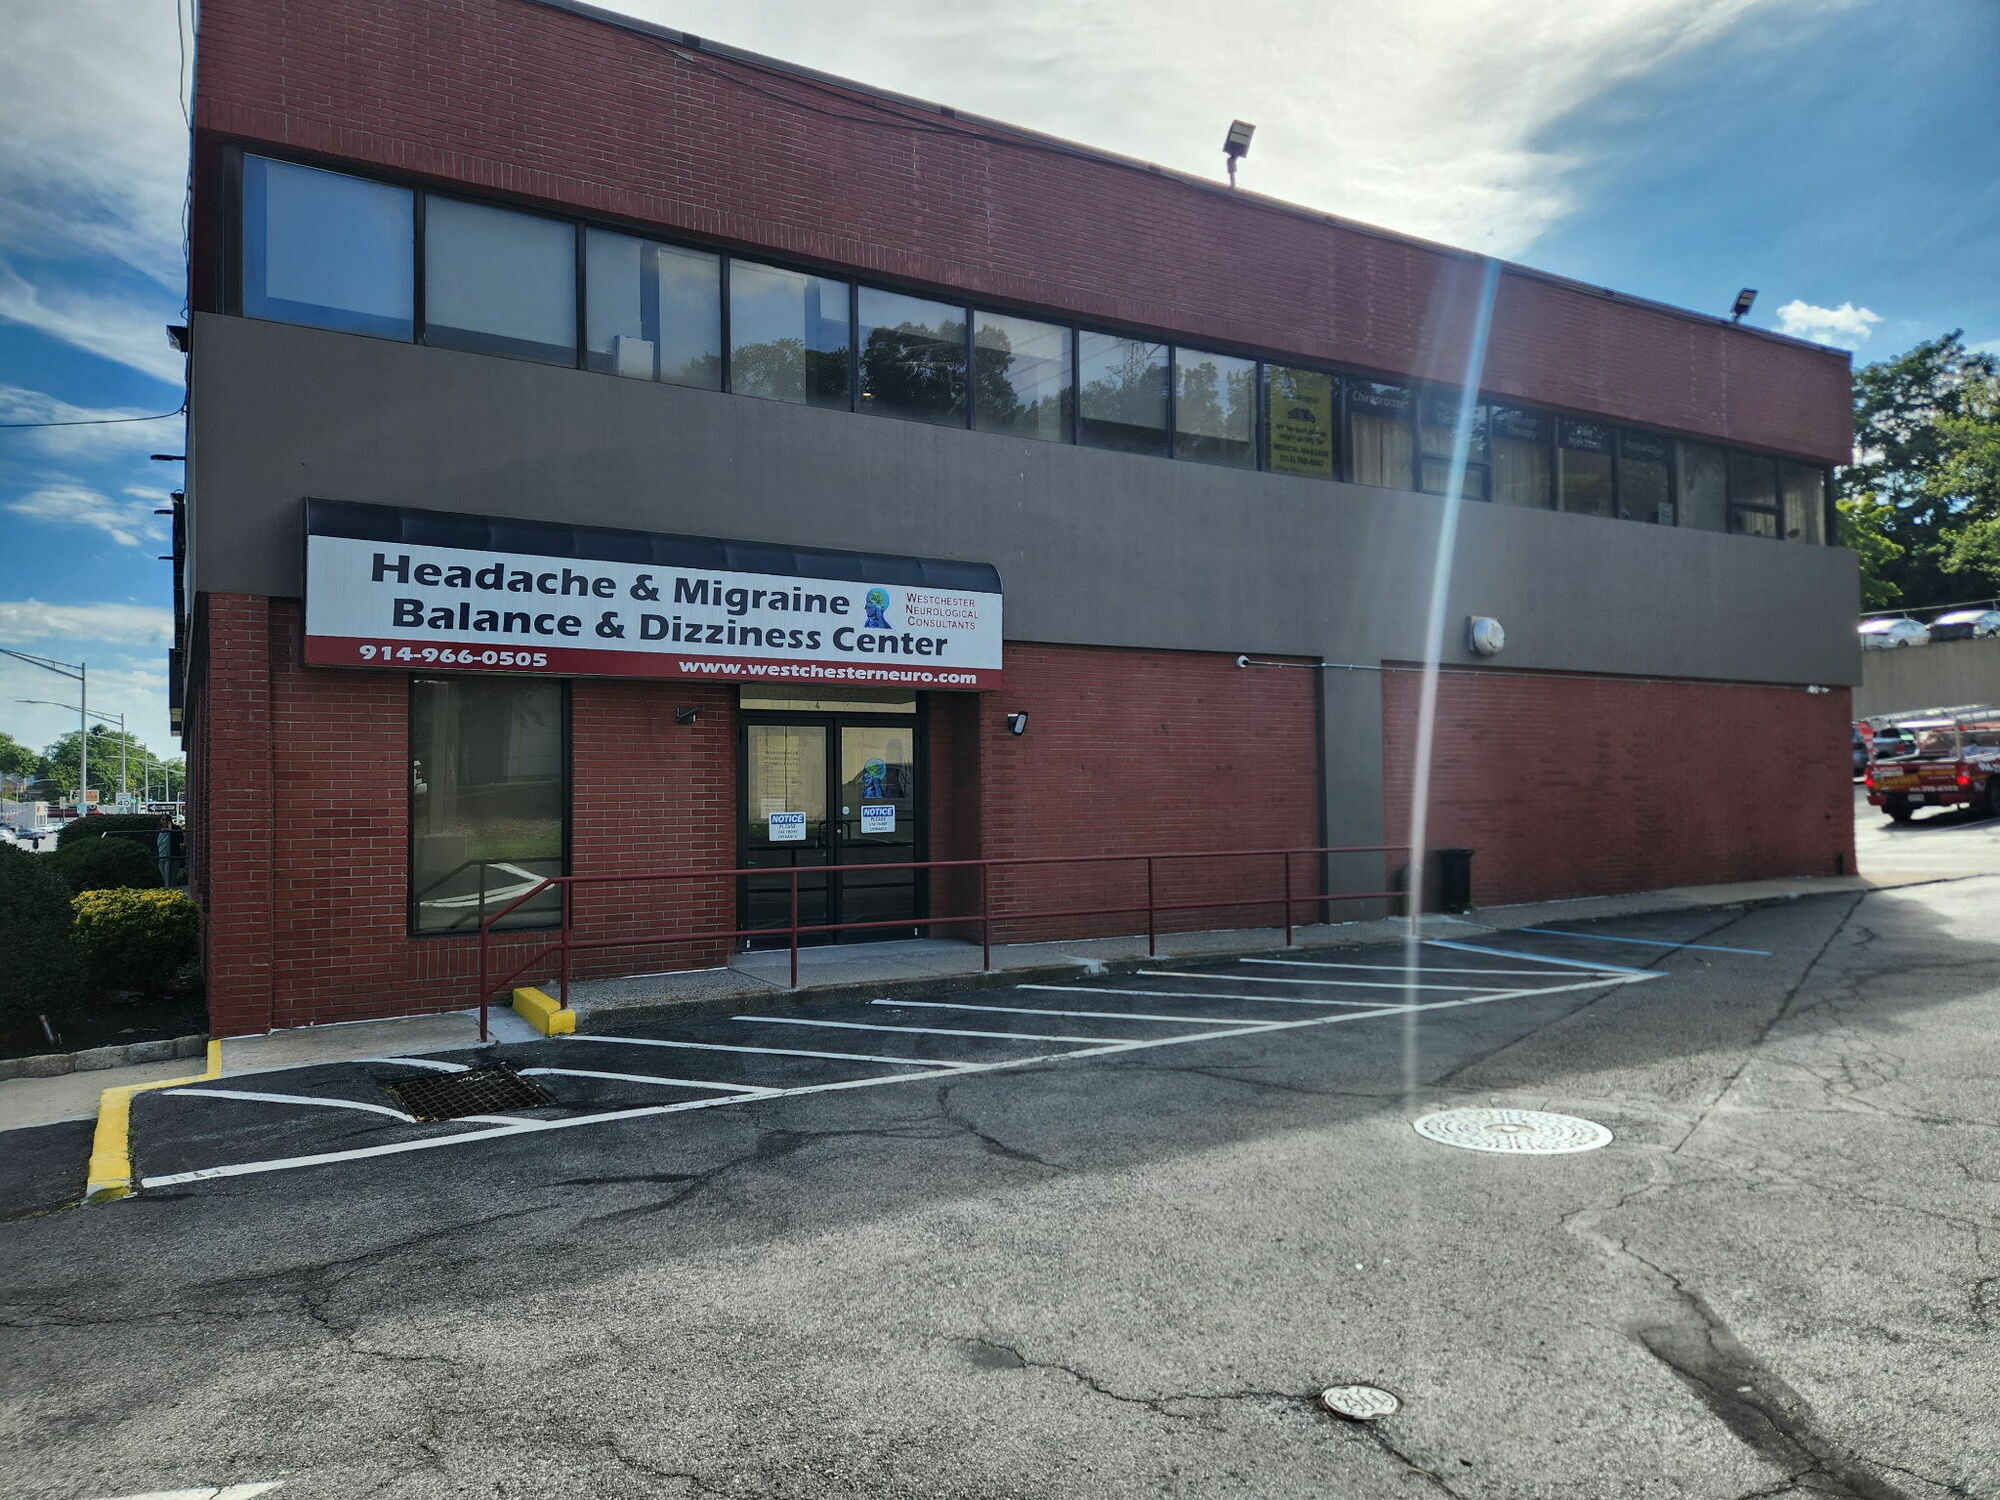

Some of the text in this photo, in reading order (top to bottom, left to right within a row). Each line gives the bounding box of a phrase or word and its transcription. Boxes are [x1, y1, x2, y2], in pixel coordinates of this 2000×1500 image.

[371, 552, 851, 617] Headache & Migraine
[906, 592, 976, 607] WESTCHESTER
[905, 604, 979, 619] NEUROLOGICAL
[392, 597, 949, 656] Balance & Dizziness Center
[907, 616, 976, 630] CONSULTANTS
[358, 644, 549, 667] 914-966-0505
[678, 660, 977, 685] www.westchesterneuro.com
[771, 814, 804, 823] NOTICE
[863, 807, 893, 816] NOTICE
